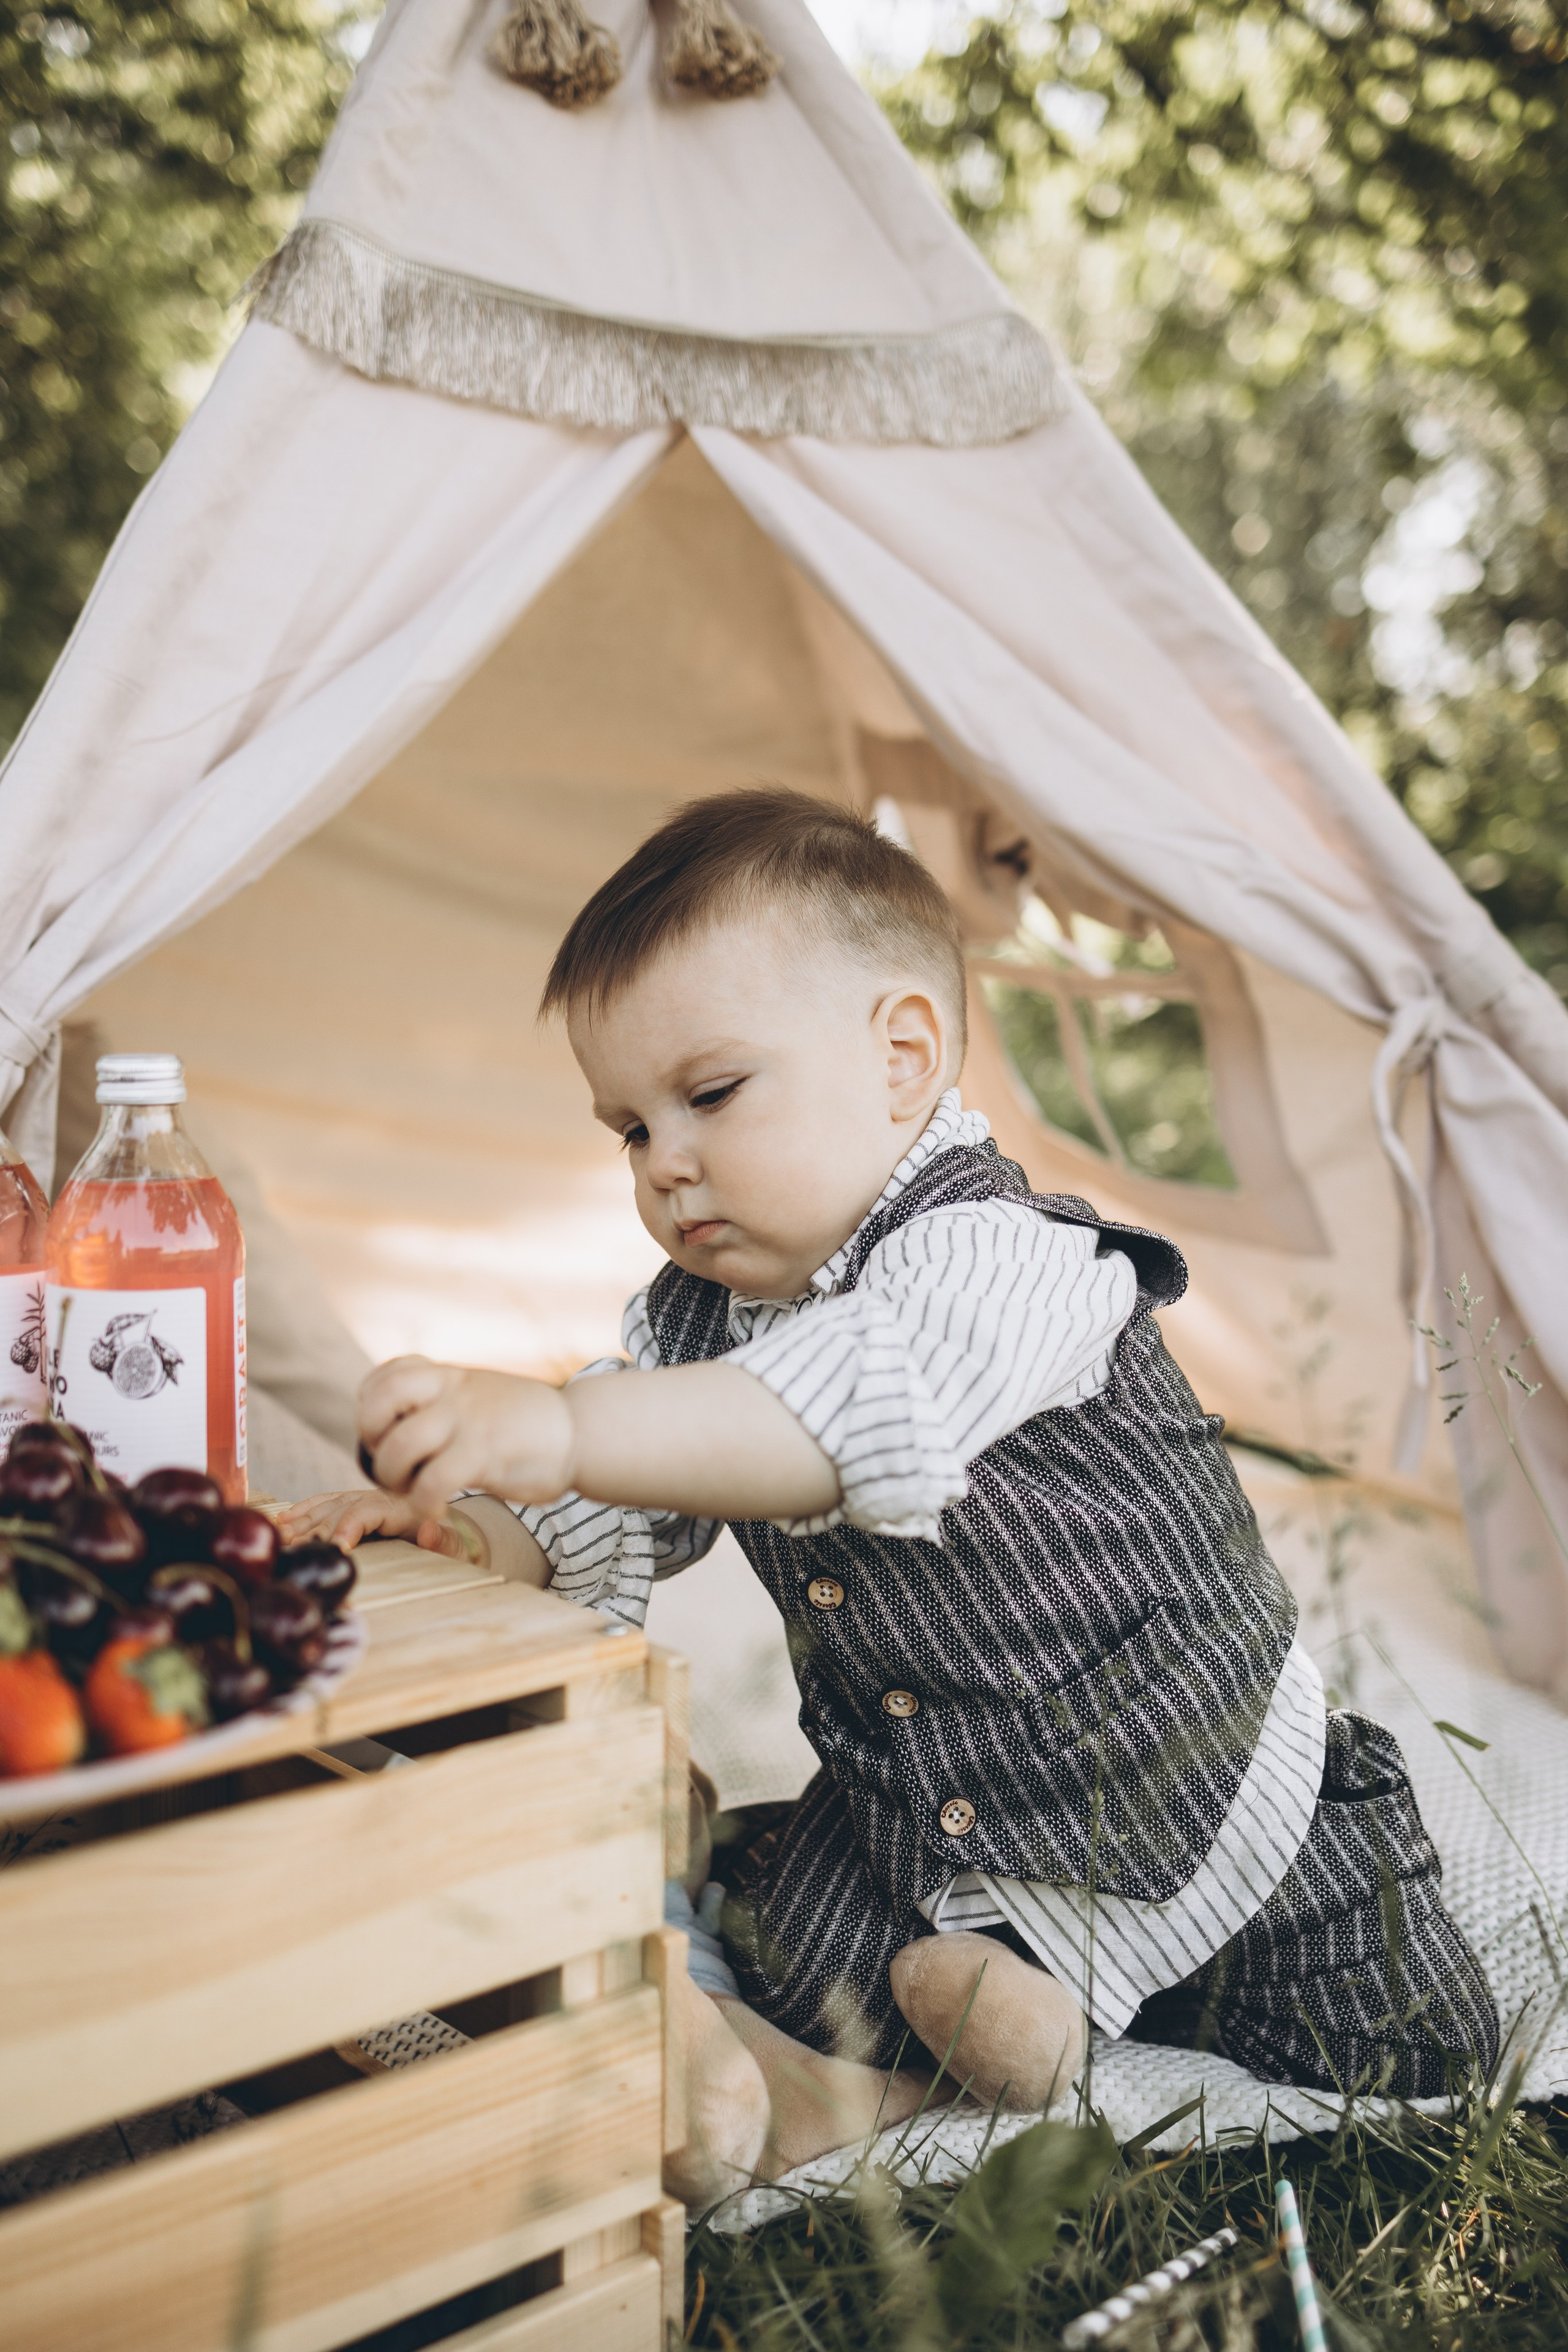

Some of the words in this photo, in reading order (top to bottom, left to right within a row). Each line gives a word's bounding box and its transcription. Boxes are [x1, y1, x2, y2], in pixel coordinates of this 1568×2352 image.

[813, 1599, 837, 1609] Classic
[884, 1693, 892, 1711] Classic
[909, 1697, 918, 1714] Classic
[941, 1800, 959, 1819] Classic
[956, 1815, 975, 1834] Classic
